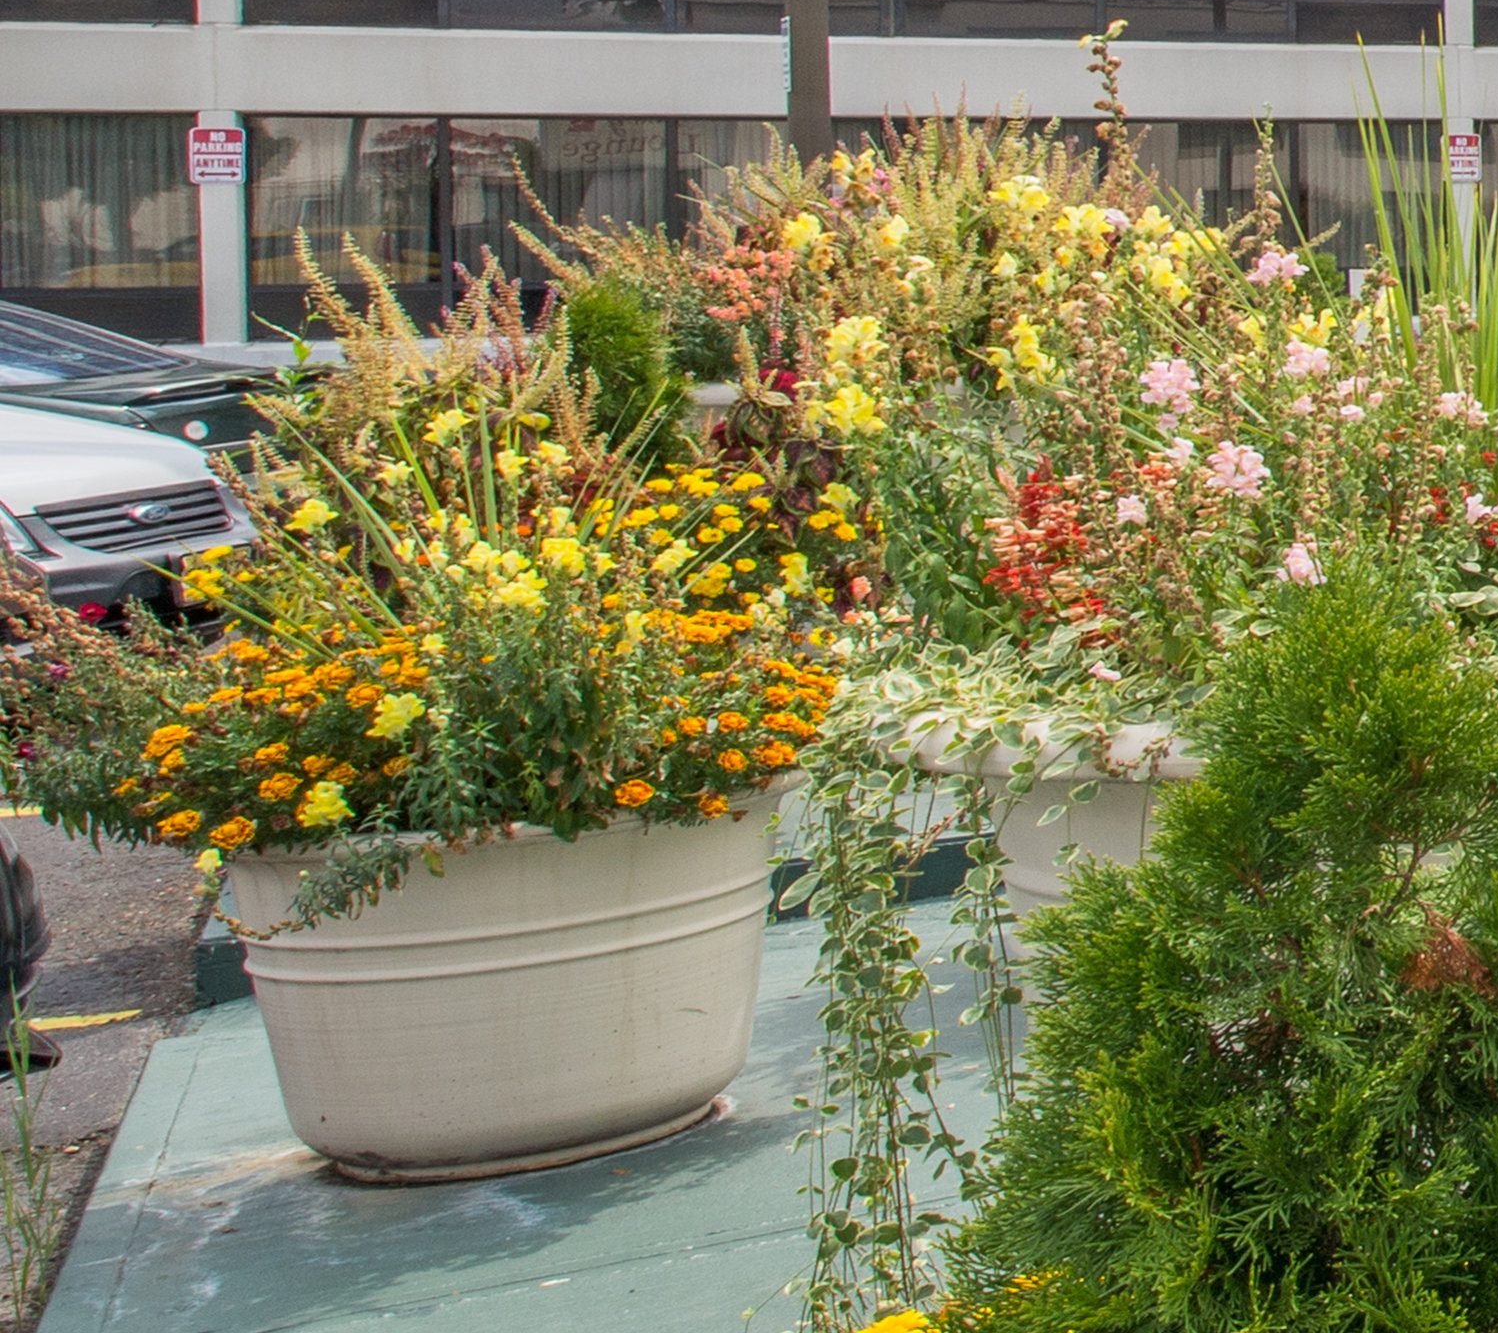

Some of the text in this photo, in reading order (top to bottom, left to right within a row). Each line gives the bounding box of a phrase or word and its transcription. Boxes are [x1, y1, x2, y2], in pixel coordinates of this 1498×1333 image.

[209, 131, 227, 142] NO
[1455, 136, 1467, 146] NO
[193, 141, 243, 153] PARKING
[1447, 145, 1479, 155] ARKING
[195, 158, 243, 168] ANYTIME
[1450, 159, 1479, 168] NYTIME
